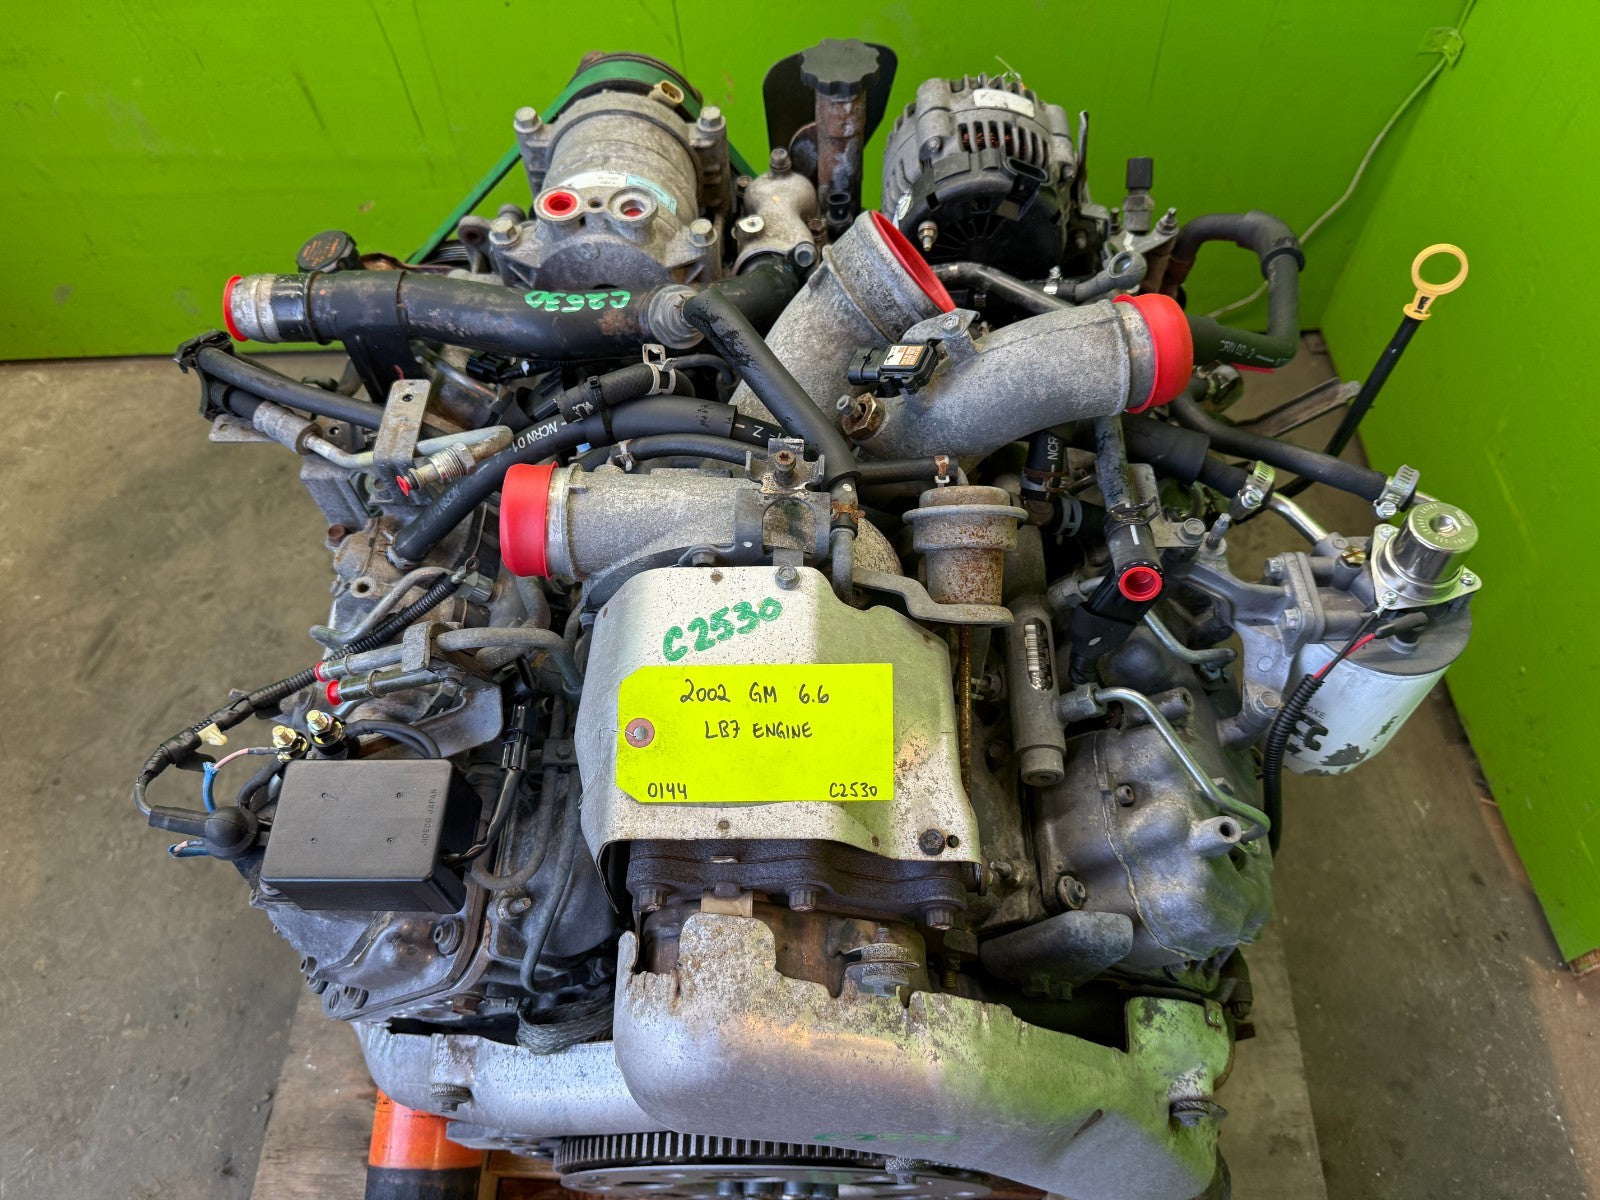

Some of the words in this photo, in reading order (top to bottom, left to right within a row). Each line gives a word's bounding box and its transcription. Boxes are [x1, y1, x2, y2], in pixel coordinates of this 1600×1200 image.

[526, 421, 558, 445] NCRN
[663, 597, 783, 661] C2530
[680, 679, 731, 703] 2002
[749, 682, 777, 703] GM
[799, 684, 830, 703] 6.6
[705, 720, 740, 738] LB7
[752, 722, 813, 738] ENGINE
[647, 783, 687, 799] 0144
[829, 782, 878, 798] C2530
